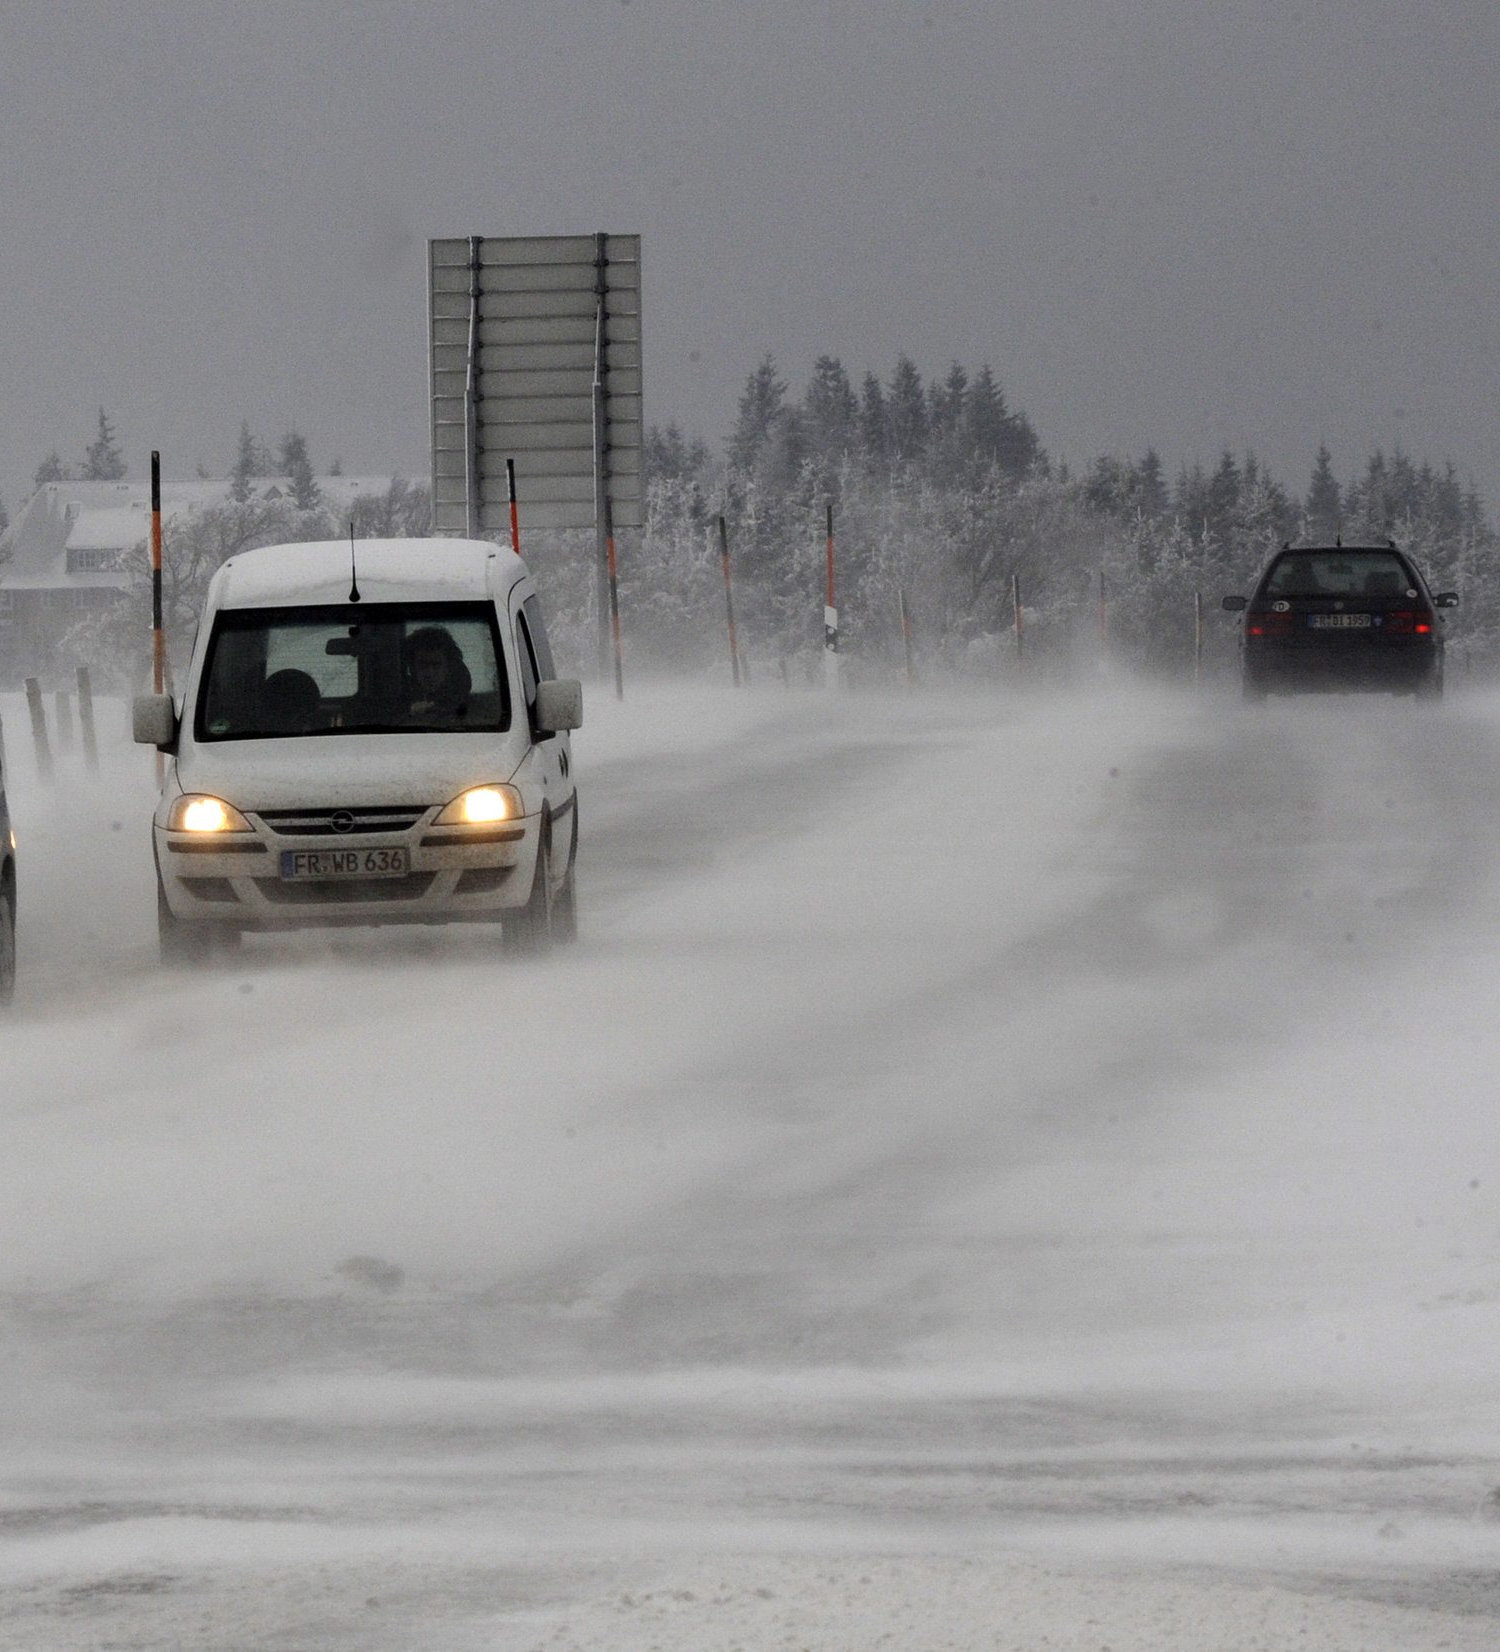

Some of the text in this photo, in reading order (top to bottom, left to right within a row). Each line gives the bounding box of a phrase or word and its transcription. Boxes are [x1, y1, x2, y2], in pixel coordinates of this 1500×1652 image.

[295, 851, 402, 874] FR WB 636
